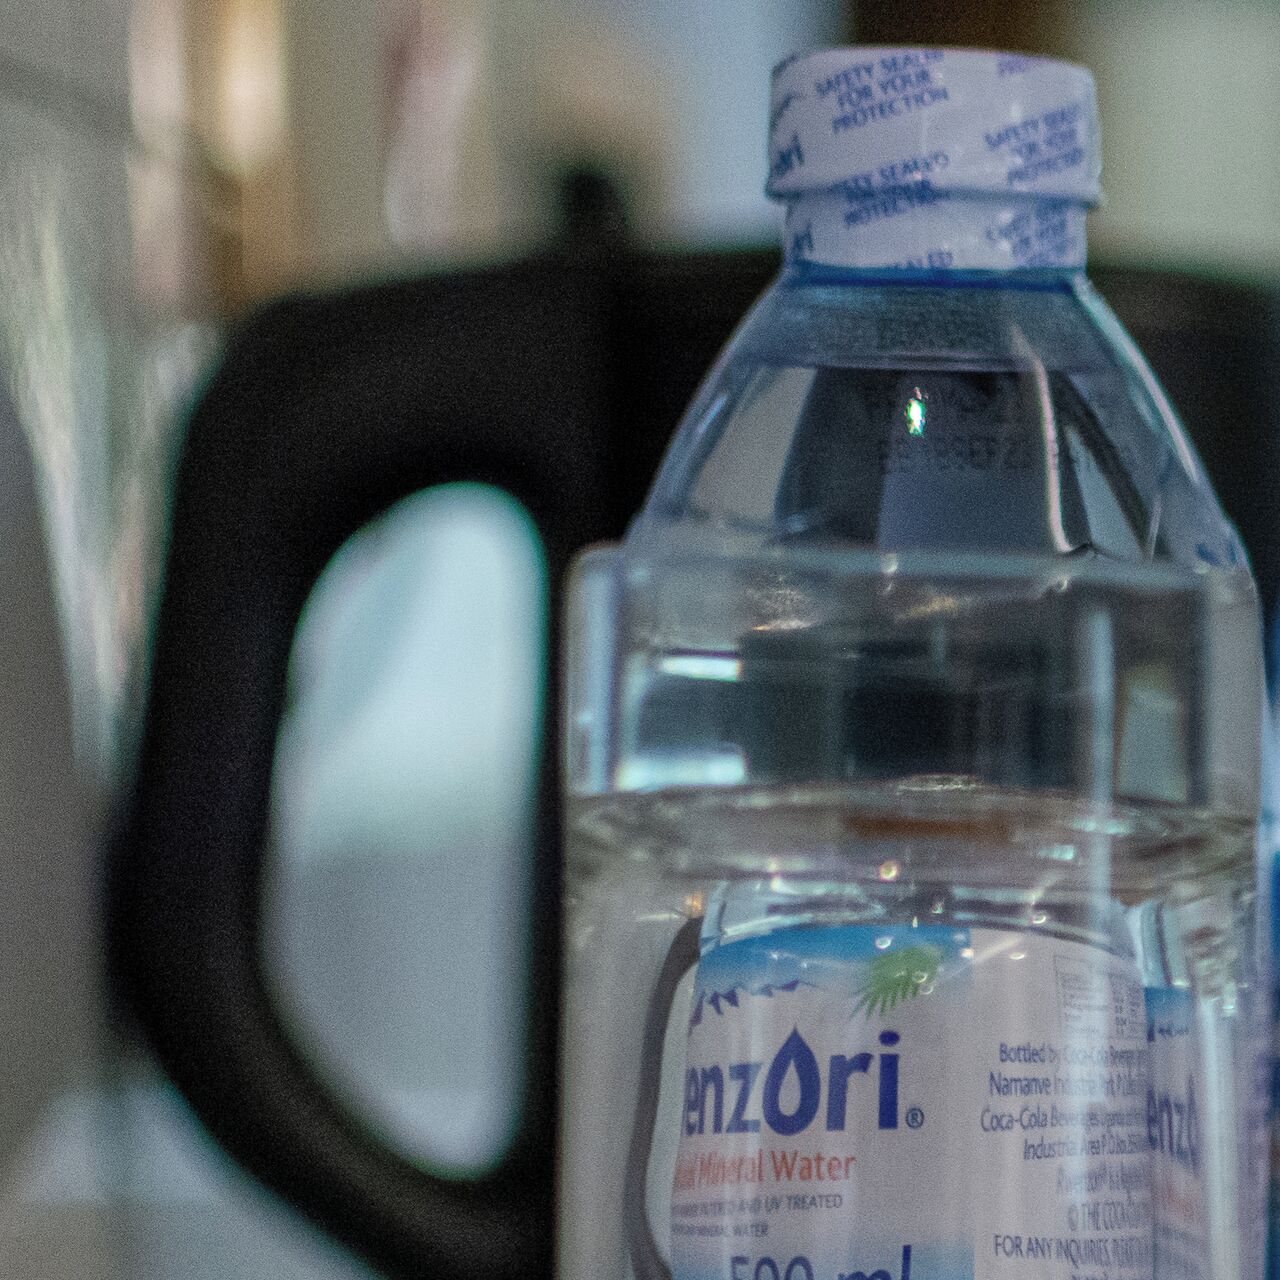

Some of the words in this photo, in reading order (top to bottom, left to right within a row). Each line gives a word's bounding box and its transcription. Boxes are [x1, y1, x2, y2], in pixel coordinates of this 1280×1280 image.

[999, 1041, 1046, 1064] Bottled
[685, 1027, 901, 1137] enzori
[980, 1104, 1049, 1133] Coca-Cola
[770, 1149, 857, 1184] Water
[785, 1192, 844, 1211] TREATED
[993, 1232, 1024, 1258] FOR
[1026, 1235, 1053, 1261] ANY
